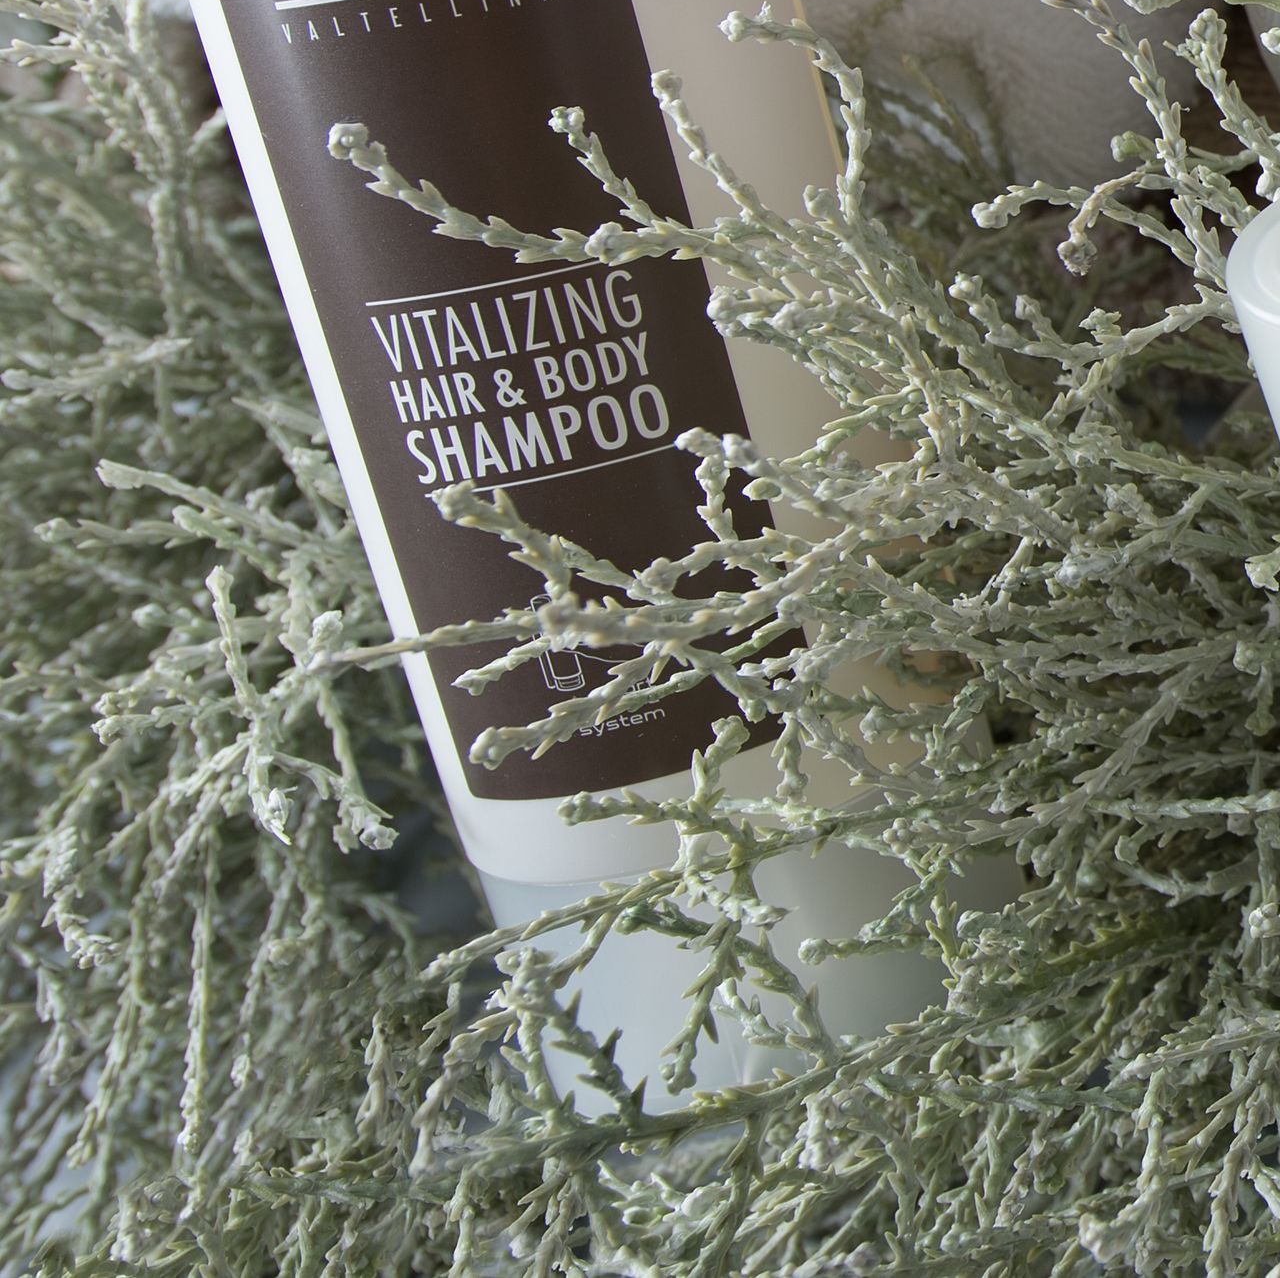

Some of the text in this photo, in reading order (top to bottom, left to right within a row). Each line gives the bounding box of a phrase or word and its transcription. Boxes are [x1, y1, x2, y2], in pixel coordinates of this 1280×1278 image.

[371, 269, 643, 373] VITALIZING
[389, 331, 649, 423] HAIR & BODY
[406, 383, 670, 485] SHAMPOO
[578, 708, 666, 737] system
